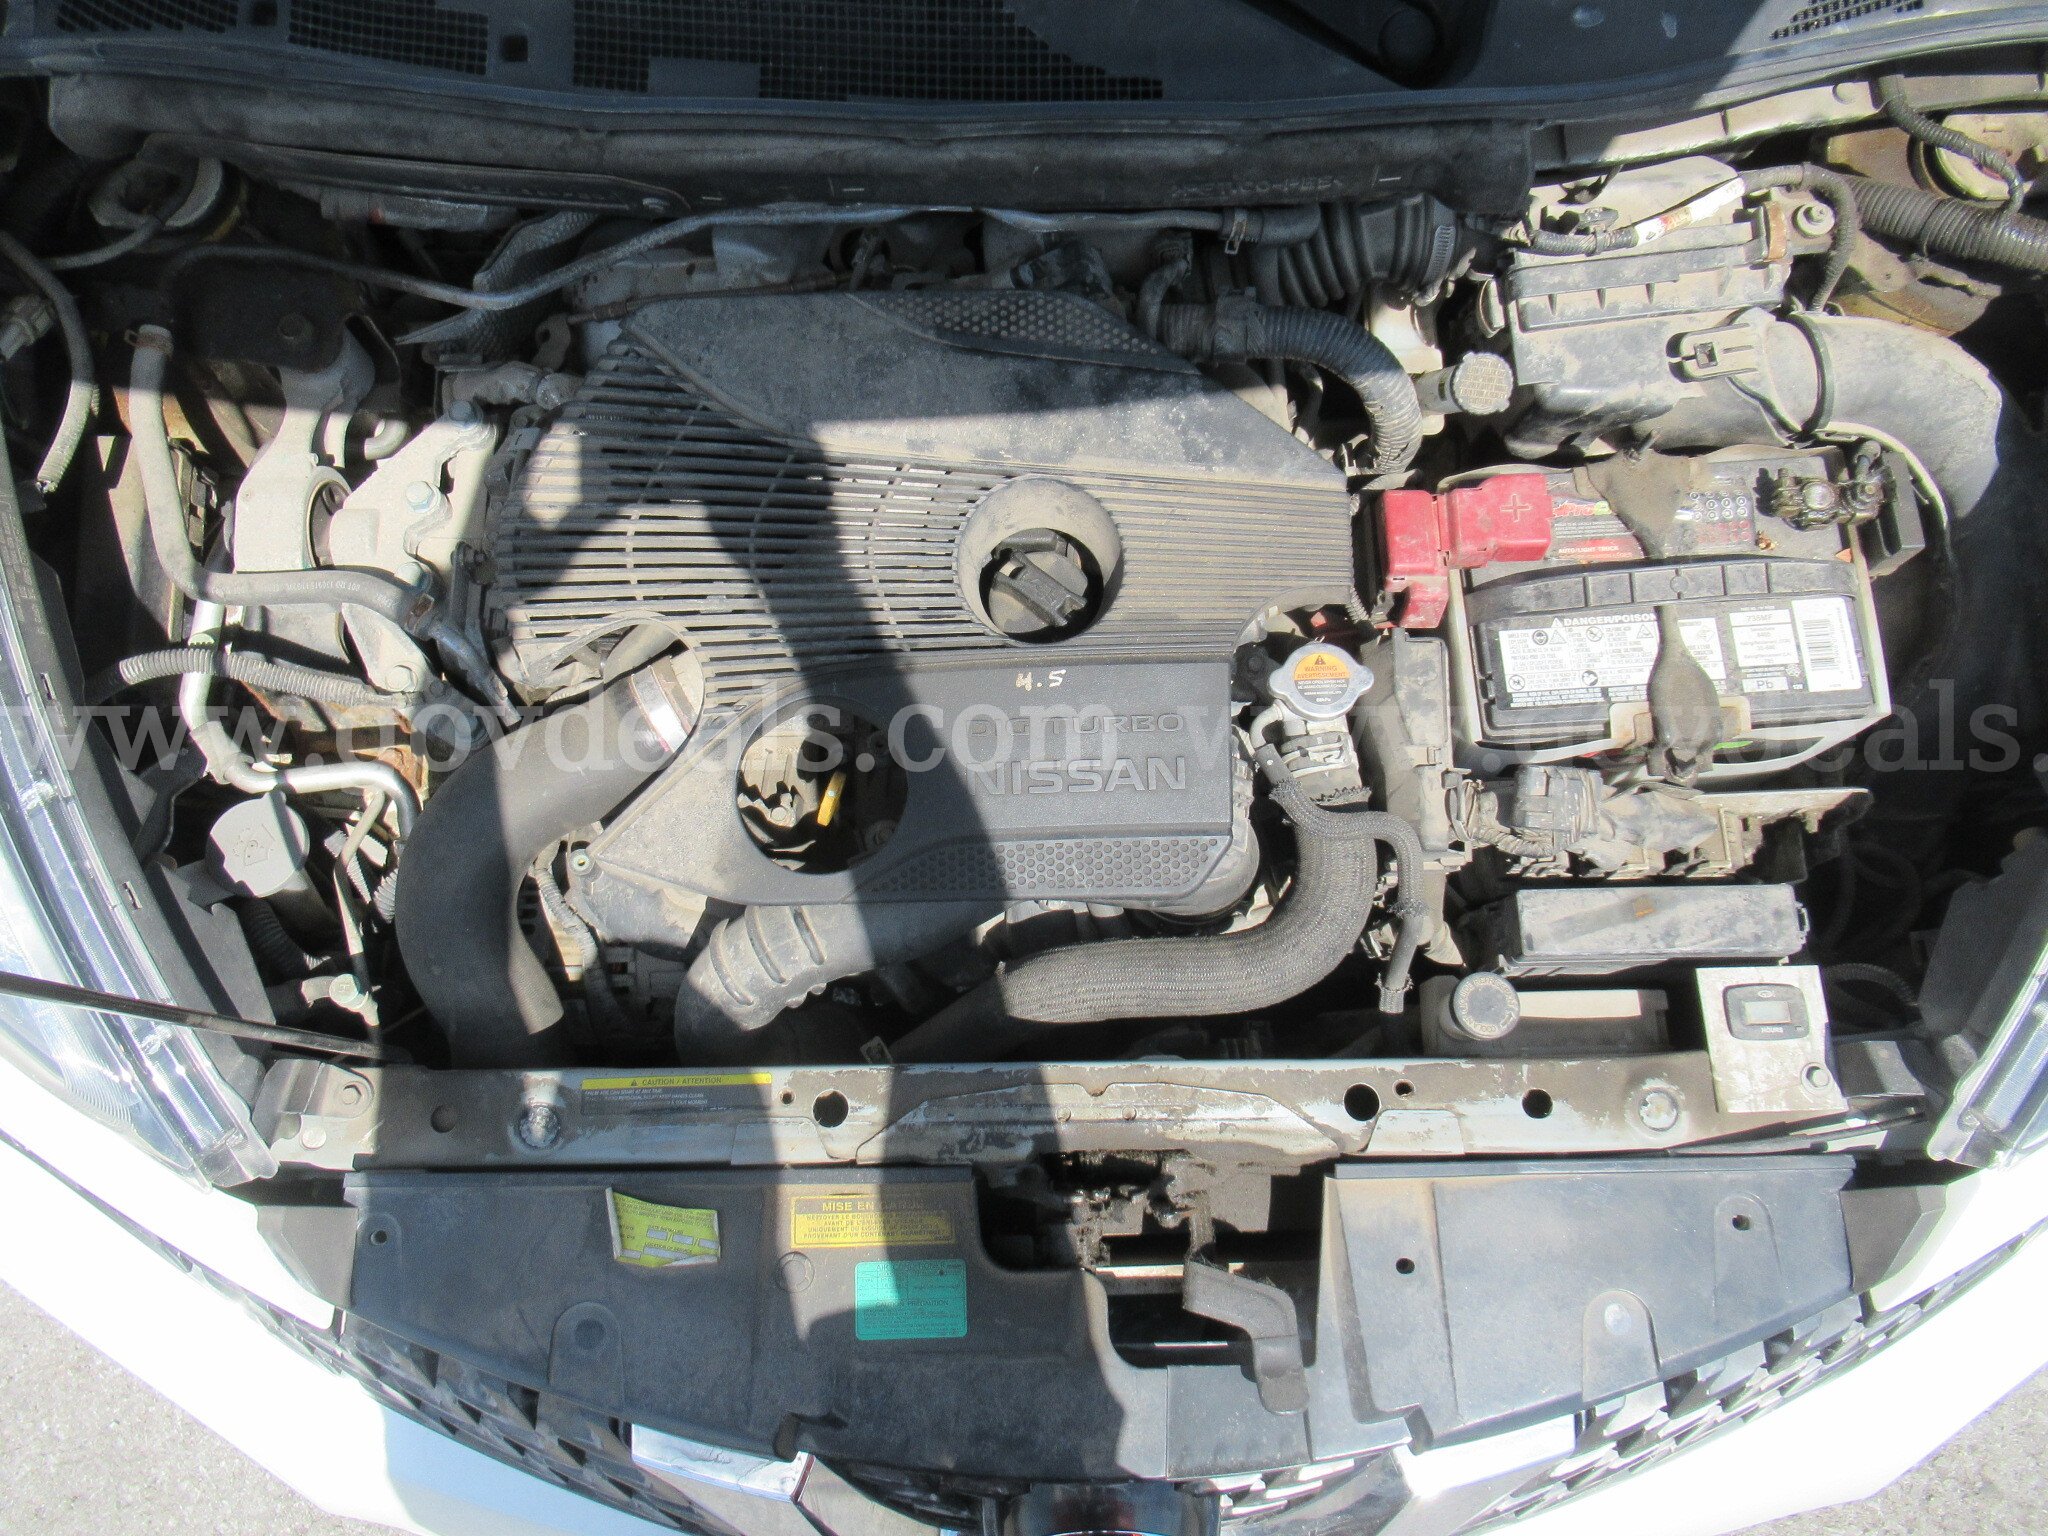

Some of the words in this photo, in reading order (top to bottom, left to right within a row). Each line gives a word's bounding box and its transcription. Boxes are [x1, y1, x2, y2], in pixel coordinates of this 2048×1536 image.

[1756, 679, 1774, 689] Pb
[1040, 712, 1185, 735] TURBO
[965, 756, 1187, 796] NISSAN
[642, 1078, 675, 1086] CAUTION
[682, 1076, 722, 1085] ATTENTION
[822, 1202, 852, 1212] MISE
[857, 1201, 875, 1210] EN
